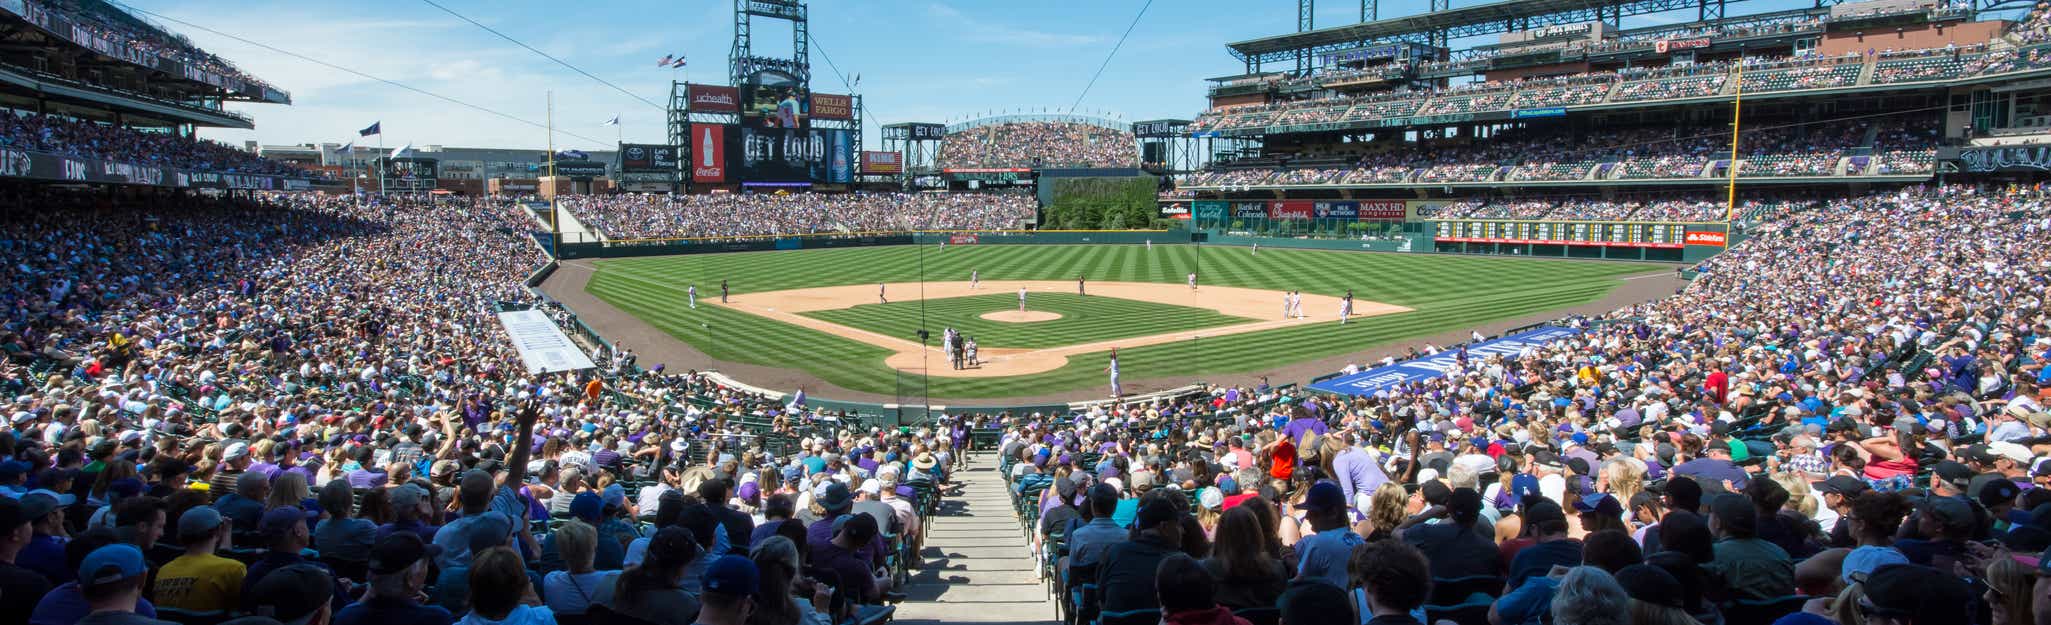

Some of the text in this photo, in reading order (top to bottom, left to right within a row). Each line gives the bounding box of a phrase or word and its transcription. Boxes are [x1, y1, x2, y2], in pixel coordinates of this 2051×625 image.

[695, 92, 734, 105] uchealth
[815, 97, 847, 105] WELLS
[815, 105, 847, 115] FARGO
[915, 126, 928, 136] GET
[1136, 125, 1149, 135] GET
[1151, 122, 1168, 134] LOUD
[744, 133, 825, 163] GET LOUD
[1360, 202, 1405, 211] MAXX HD
[1237, 210, 1267, 218] Colorado
